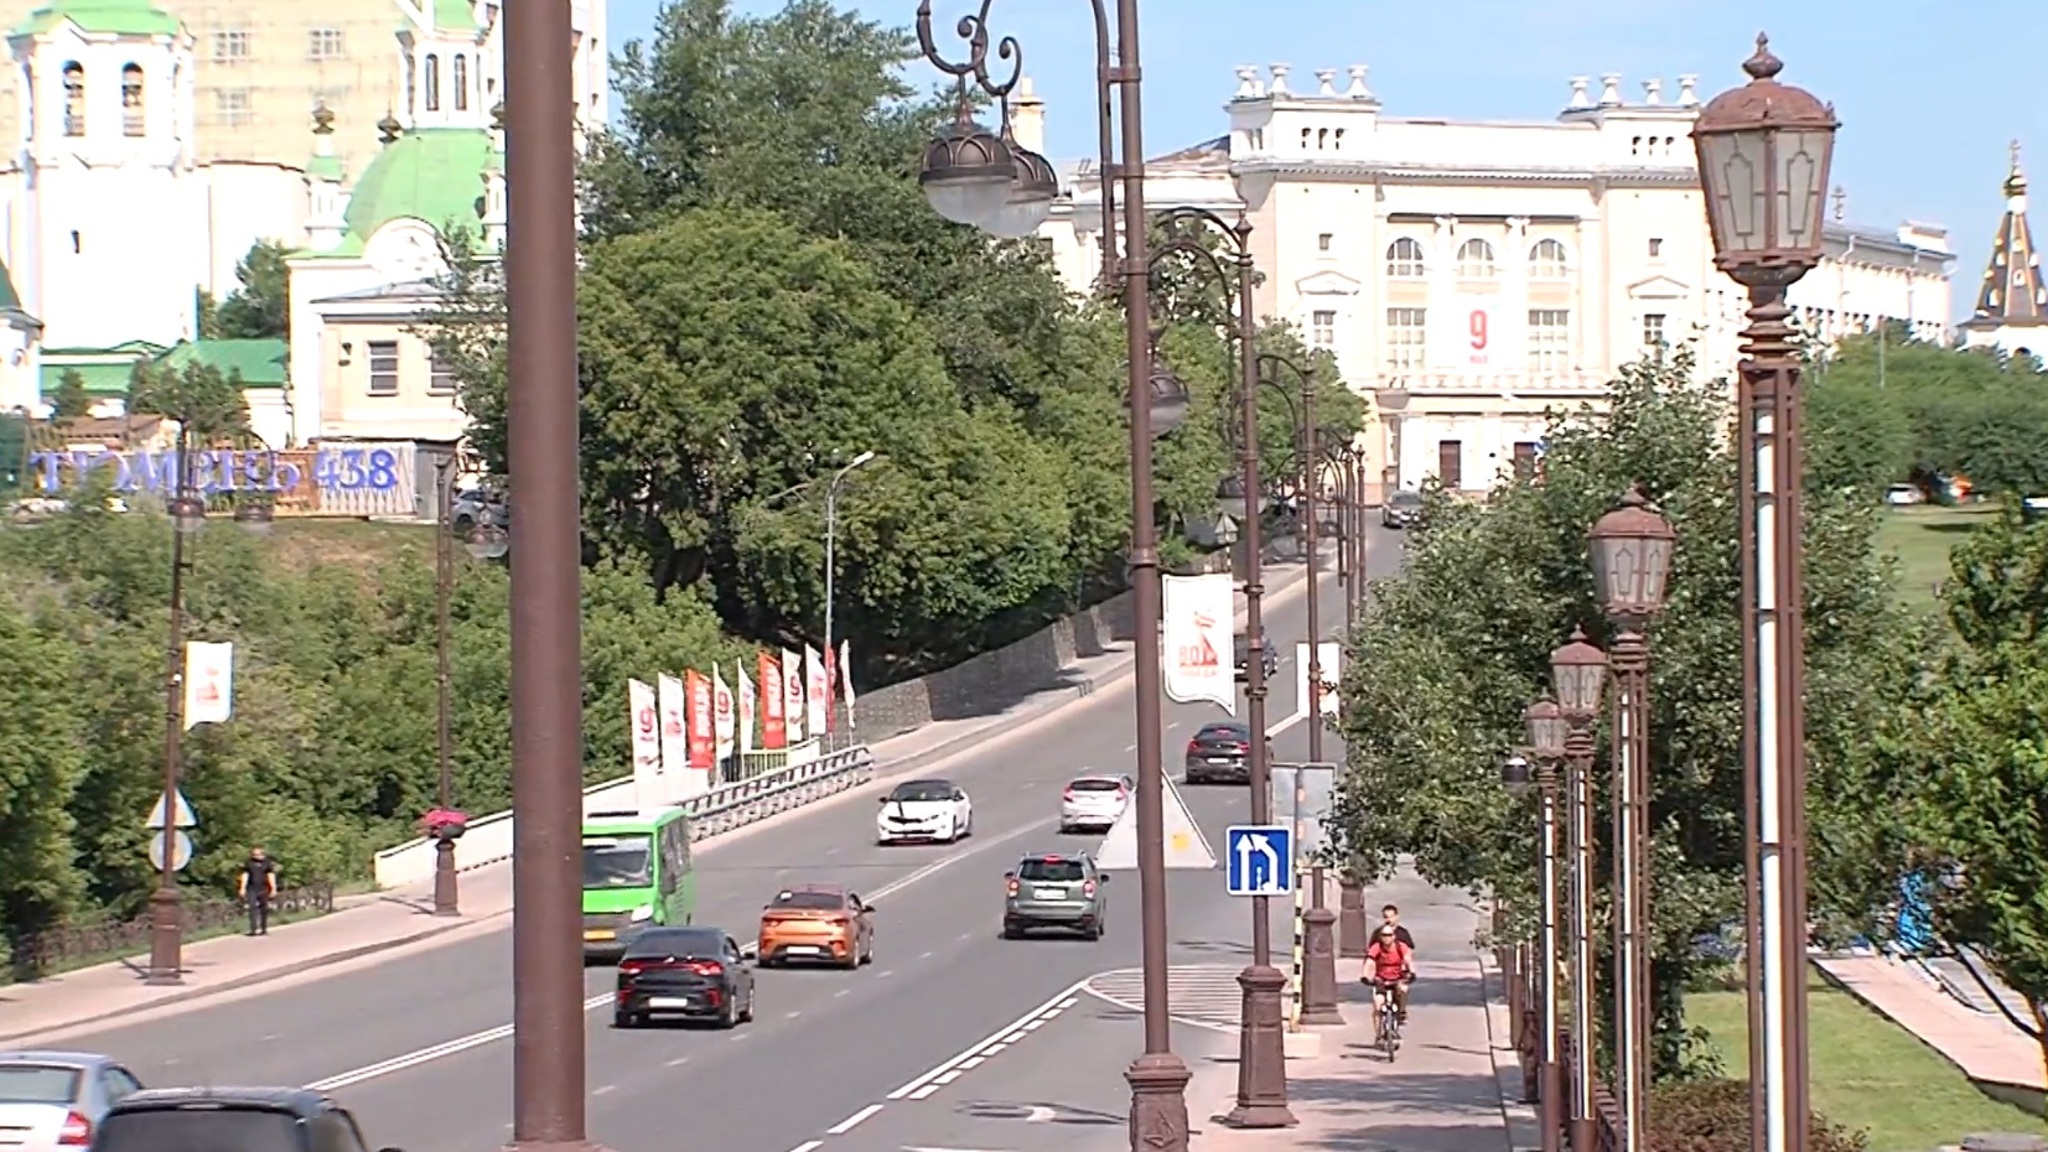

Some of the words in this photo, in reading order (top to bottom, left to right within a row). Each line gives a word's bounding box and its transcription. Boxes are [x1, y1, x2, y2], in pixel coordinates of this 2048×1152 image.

[1470, 309, 1487, 350] 9
[314, 448, 398, 491] 438
[640, 706, 654, 733] 9
[717, 691, 730, 714] 9
